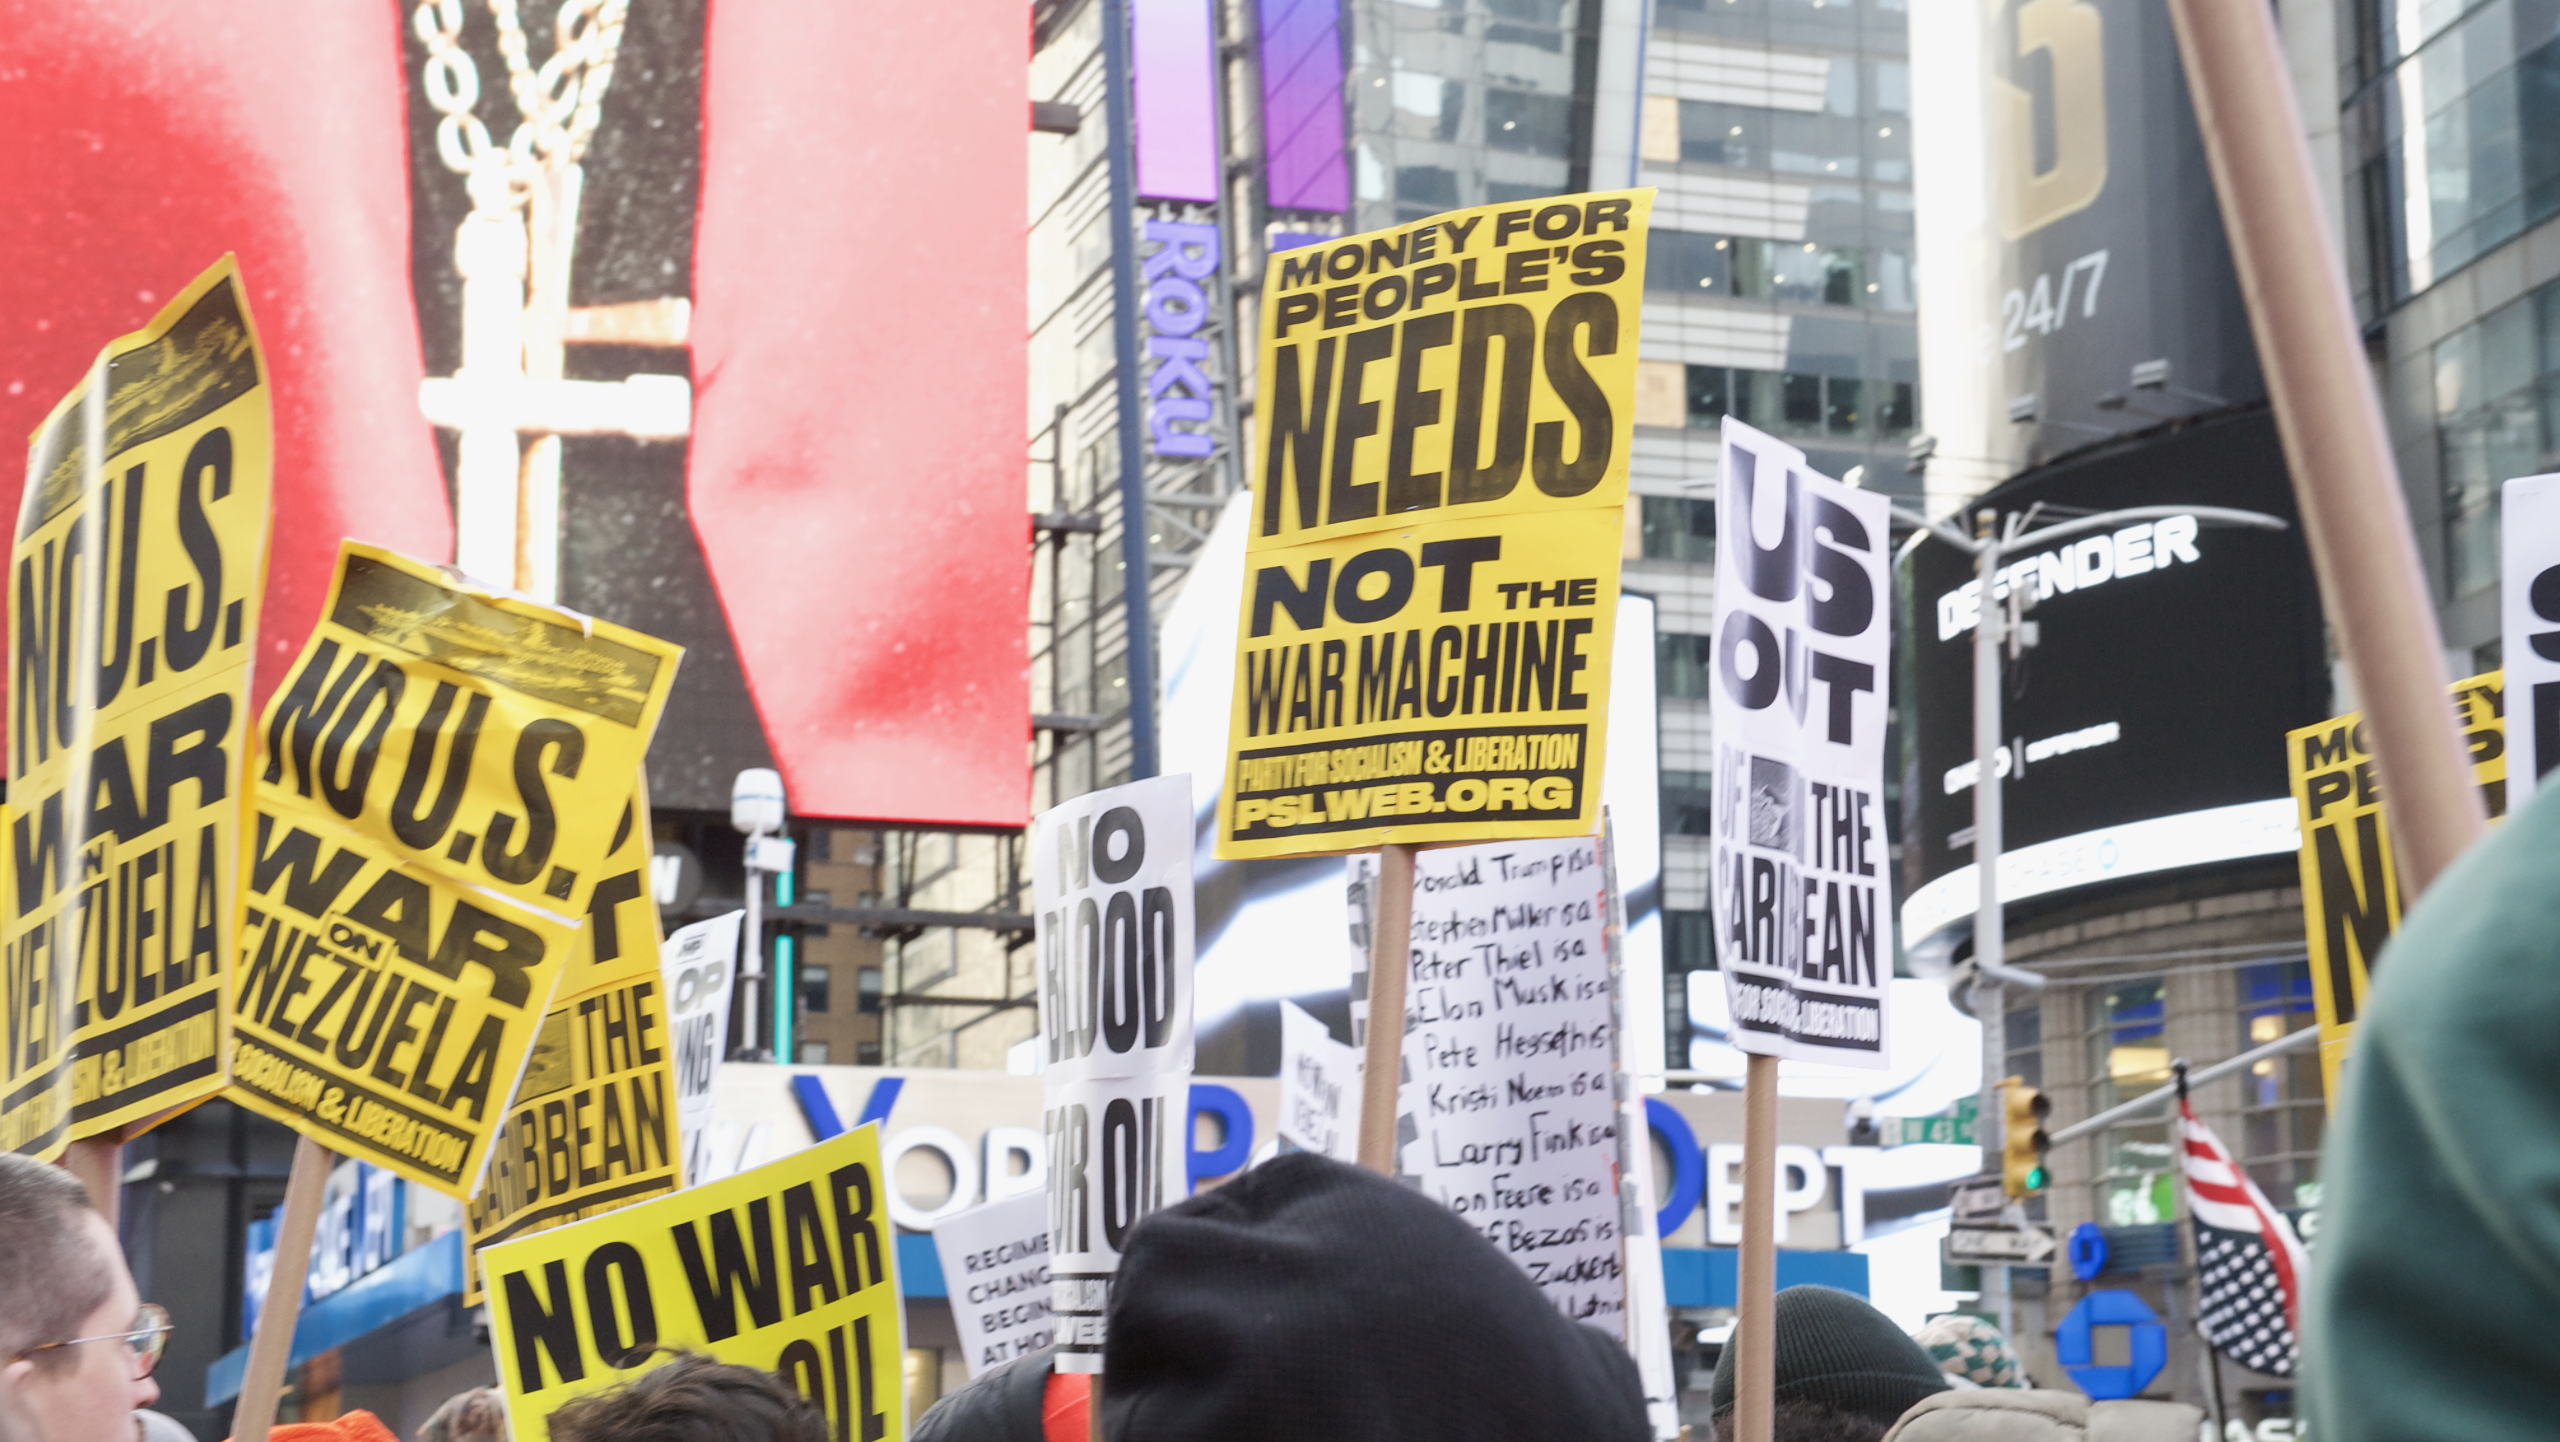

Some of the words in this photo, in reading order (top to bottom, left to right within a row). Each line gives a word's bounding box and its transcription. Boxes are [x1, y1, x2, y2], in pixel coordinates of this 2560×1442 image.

[1276, 239, 1627, 339] PEOPLE'S
[1280, 215, 1483, 292] MONEY
[1495, 198, 1632, 247] FOR
[2002, 249, 2109, 354] 24/7
[1261, 291, 1620, 537] NEEDS
[94, 426, 247, 710] U.S.
[1250, 535, 1502, 638] NOT
[1498, 577, 1597, 610] THE
[1729, 441, 1875, 638] US
[1246, 637, 1346, 739] WAR
[1356, 616, 1593, 726] MACHINE
[1719, 608, 1875, 747] OUT
[261, 636, 406, 821] NO
[390, 679, 586, 902] U.S.
[1424, 739, 1453, 774] &
[1453, 732, 1580, 773] LIBERATION
[12, 691, 234, 922] WAR
[1056, 805, 1145, 899] NO
[1234, 776, 1574, 832] PSLWEB.ORG
[1811, 780, 1877, 878] THE
[250, 810, 546, 1010] WAR
[1490, 852, 1564, 887] Trump
[329, 921, 383, 961] ON
[1044, 886, 1175, 1066] BLOOD
[1410, 948, 1472, 982] Peter
[1471, 939, 1544, 978] Thiel
[572, 981, 662, 1079] THE
[1417, 985, 1484, 1023] Elon
[1493, 974, 1570, 1011] Musk
[1424, 1032, 1478, 1070] Pete
[315, 1086, 348, 1125] &
[341, 1095, 469, 1174] LIBERATION
[1432, 1128, 1523, 1168] Larry
[1528, 1111, 1584, 1162] Fink
[501, 1240, 660, 1395] NO
[671, 1162, 885, 1344] WAR
[966, 1264, 1052, 1304] CHANG
[983, 1341, 1009, 1367] AT
